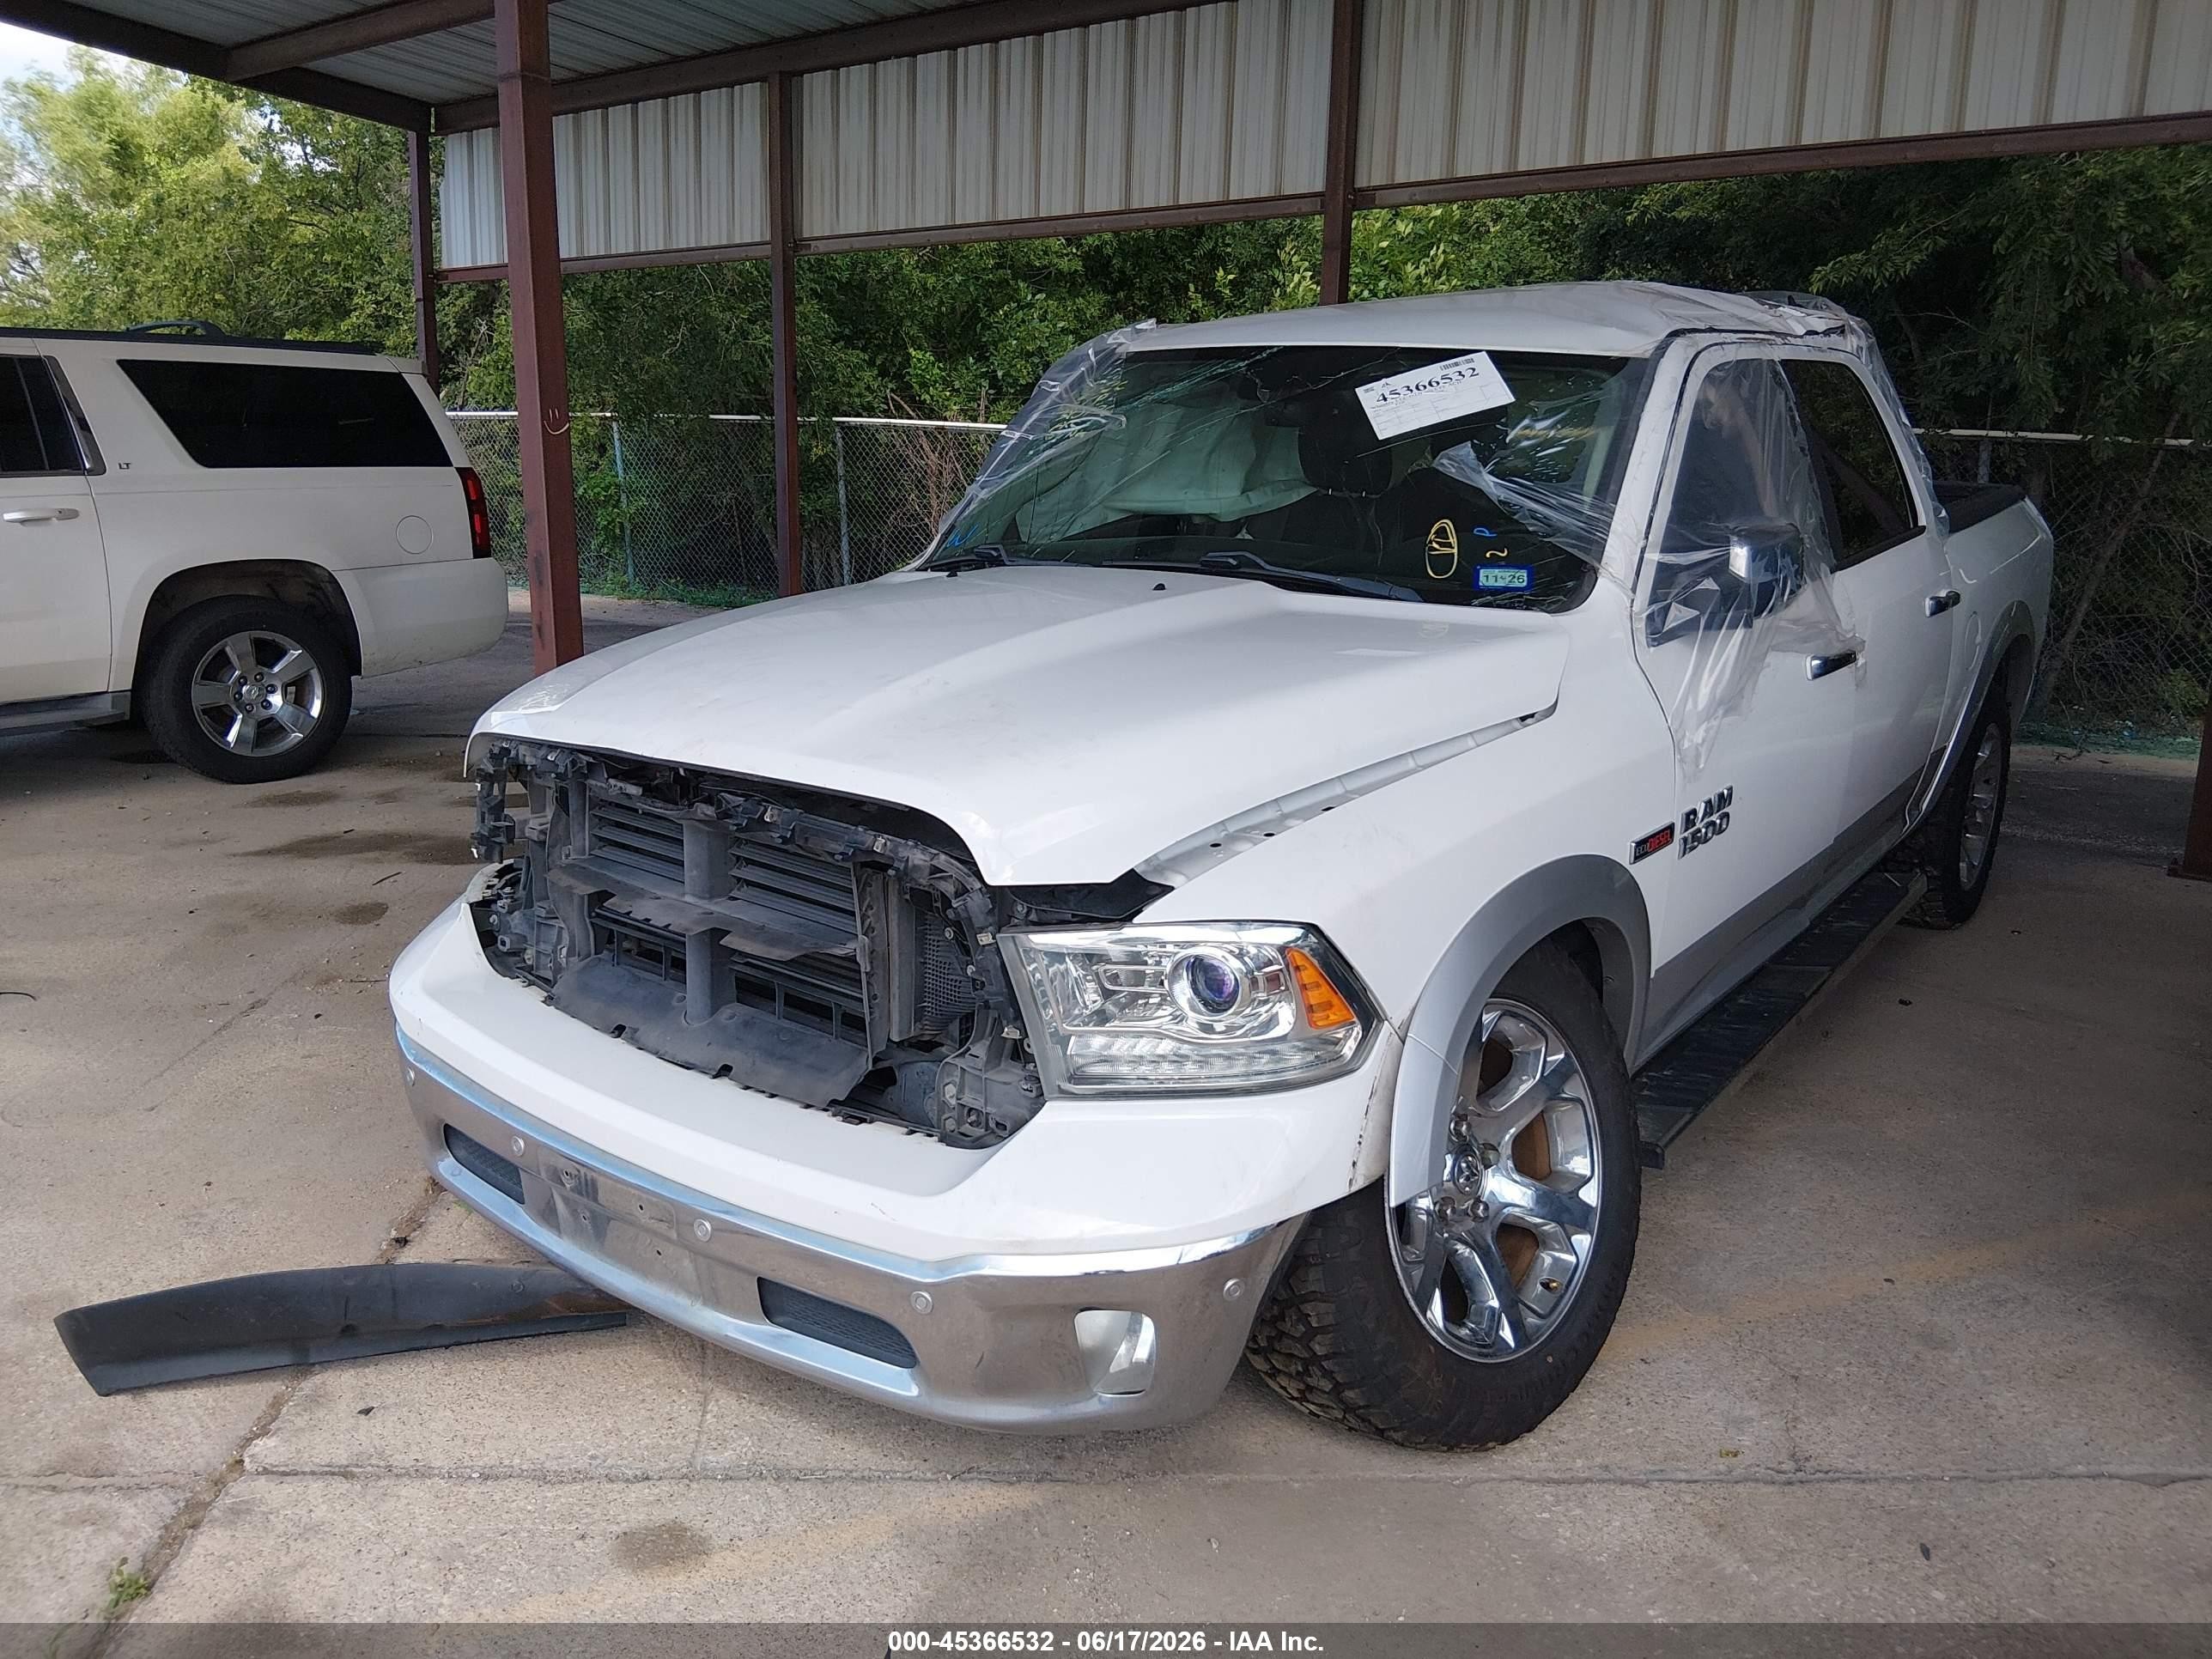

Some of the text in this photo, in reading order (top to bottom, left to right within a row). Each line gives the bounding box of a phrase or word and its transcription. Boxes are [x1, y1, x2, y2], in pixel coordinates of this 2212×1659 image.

[1376, 367, 1480, 404] 45366532
[1680, 785, 1733, 836] RAM
[1677, 811, 1730, 860] 1500
